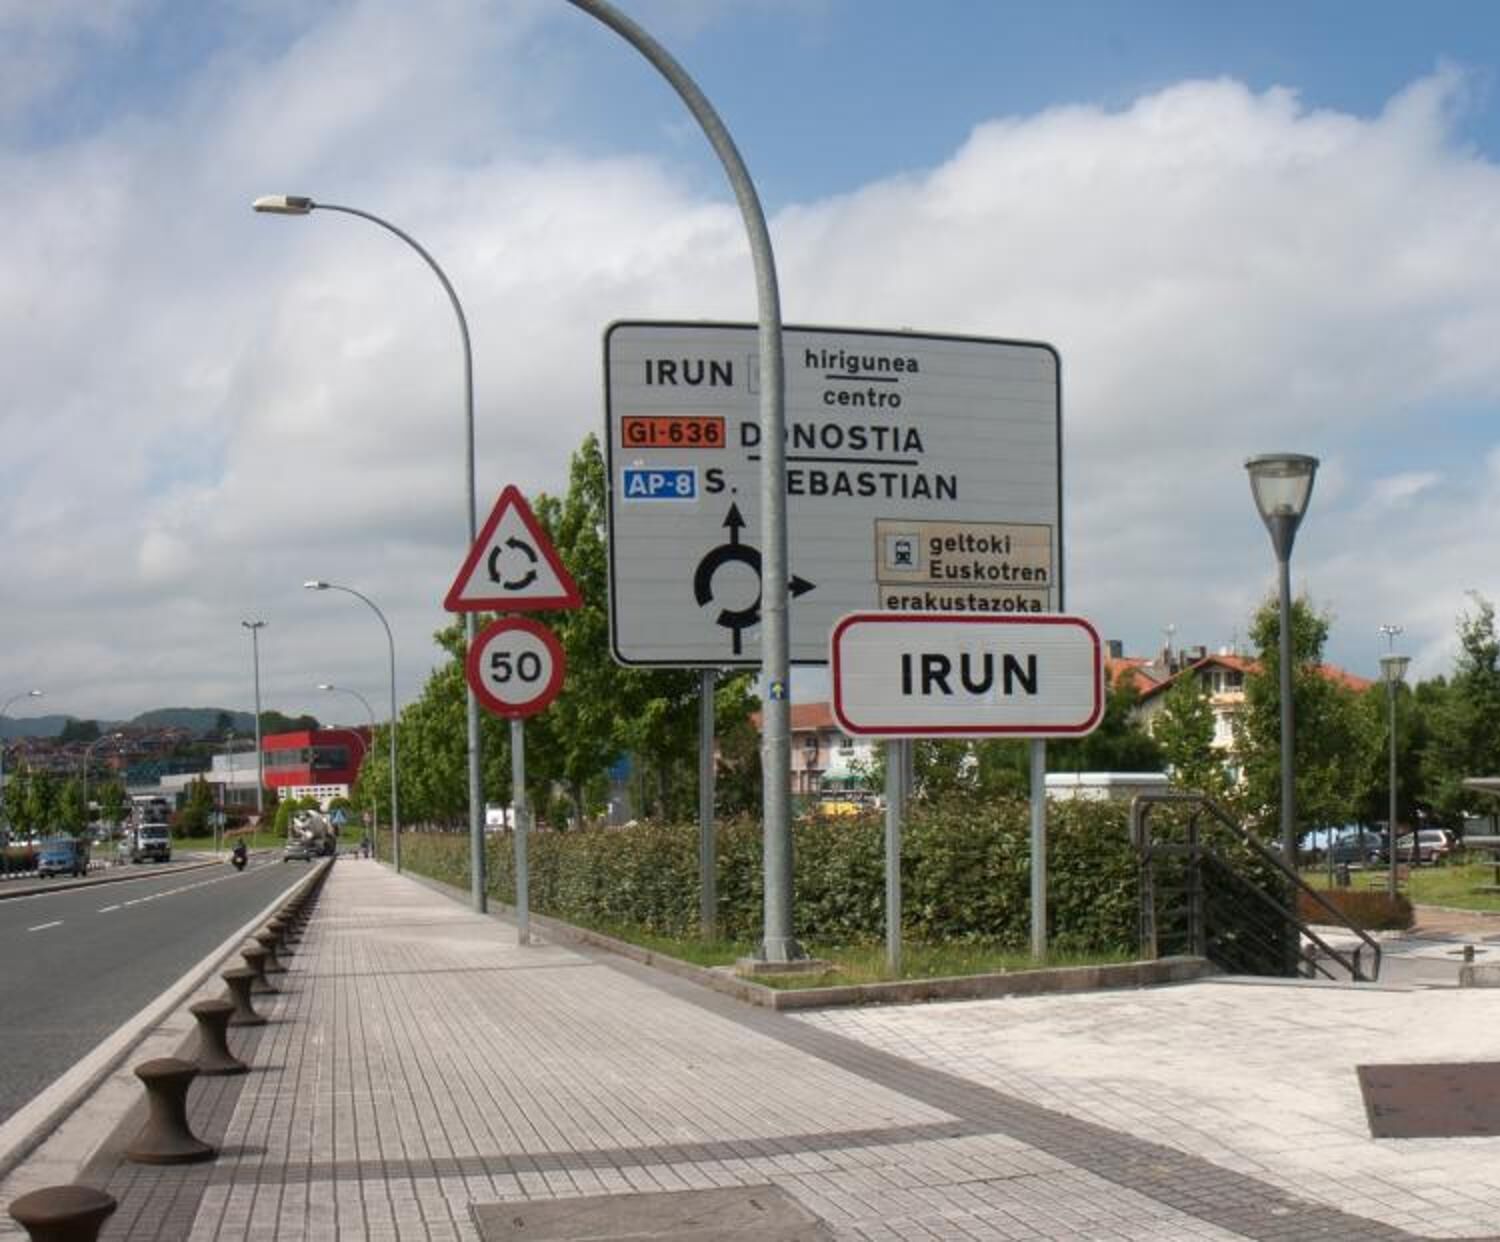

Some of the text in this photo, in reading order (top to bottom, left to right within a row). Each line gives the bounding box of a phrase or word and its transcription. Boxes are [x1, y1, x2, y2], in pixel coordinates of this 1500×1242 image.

[645, 359, 733, 387] IRUN
[805, 348, 919, 375] hirigunea
[823, 387, 902, 408] centro
[627, 421, 720, 444] GI-636
[740, 421, 924, 453] DNOSTIA
[628, 472, 692, 496] AP-8
[705, 468, 957, 500] S. EBASTIAN
[929, 533, 1011, 556] geltoki
[929, 559, 1047, 582] Euskotren
[886, 591, 1043, 613] erakustazoka
[491, 651, 542, 684] 50
[901, 652, 1039, 695] IRUN
